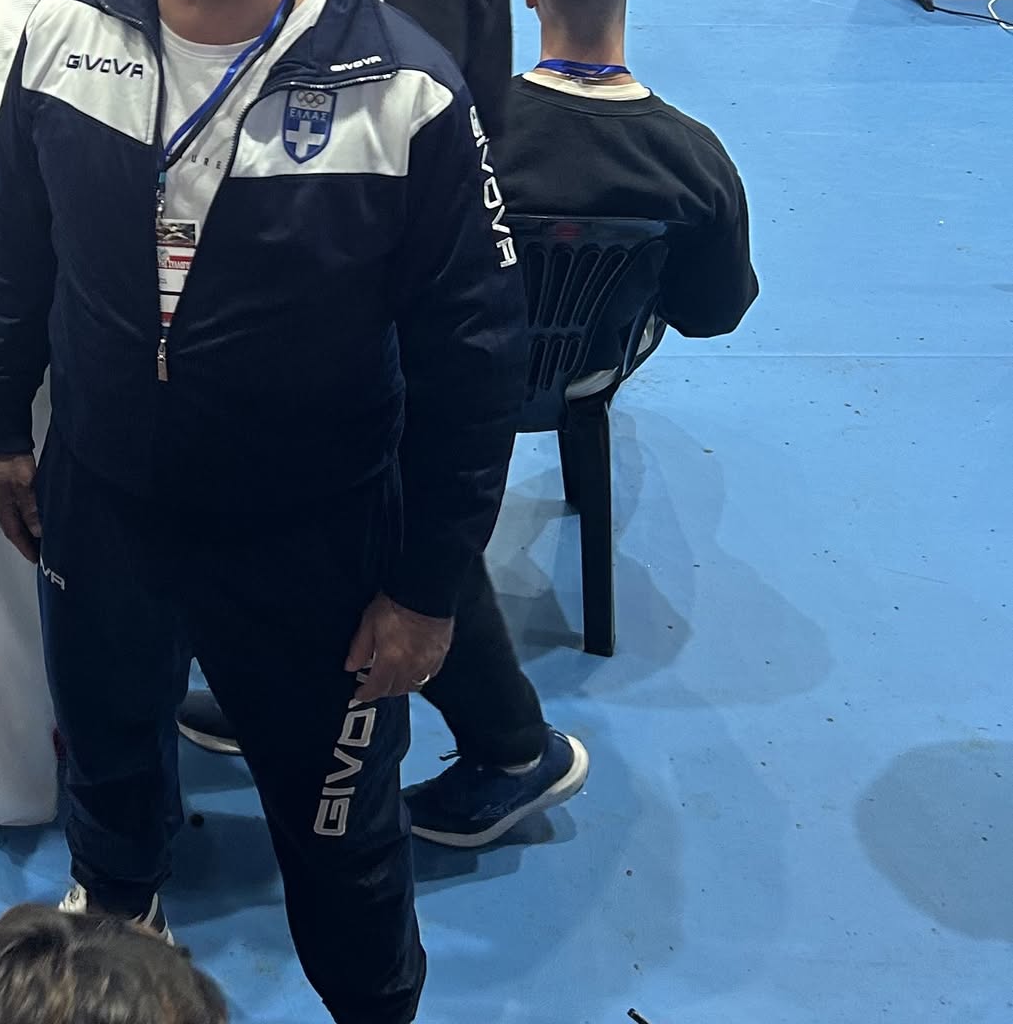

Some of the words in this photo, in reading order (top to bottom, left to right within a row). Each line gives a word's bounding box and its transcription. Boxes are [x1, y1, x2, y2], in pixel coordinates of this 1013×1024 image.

[66, 54, 144, 79] GIVOVA
[329, 55, 382, 72] GIVOVA
[289, 107, 327, 122] ΕΛΛΑΣ
[313, 676, 377, 836] GIVO
